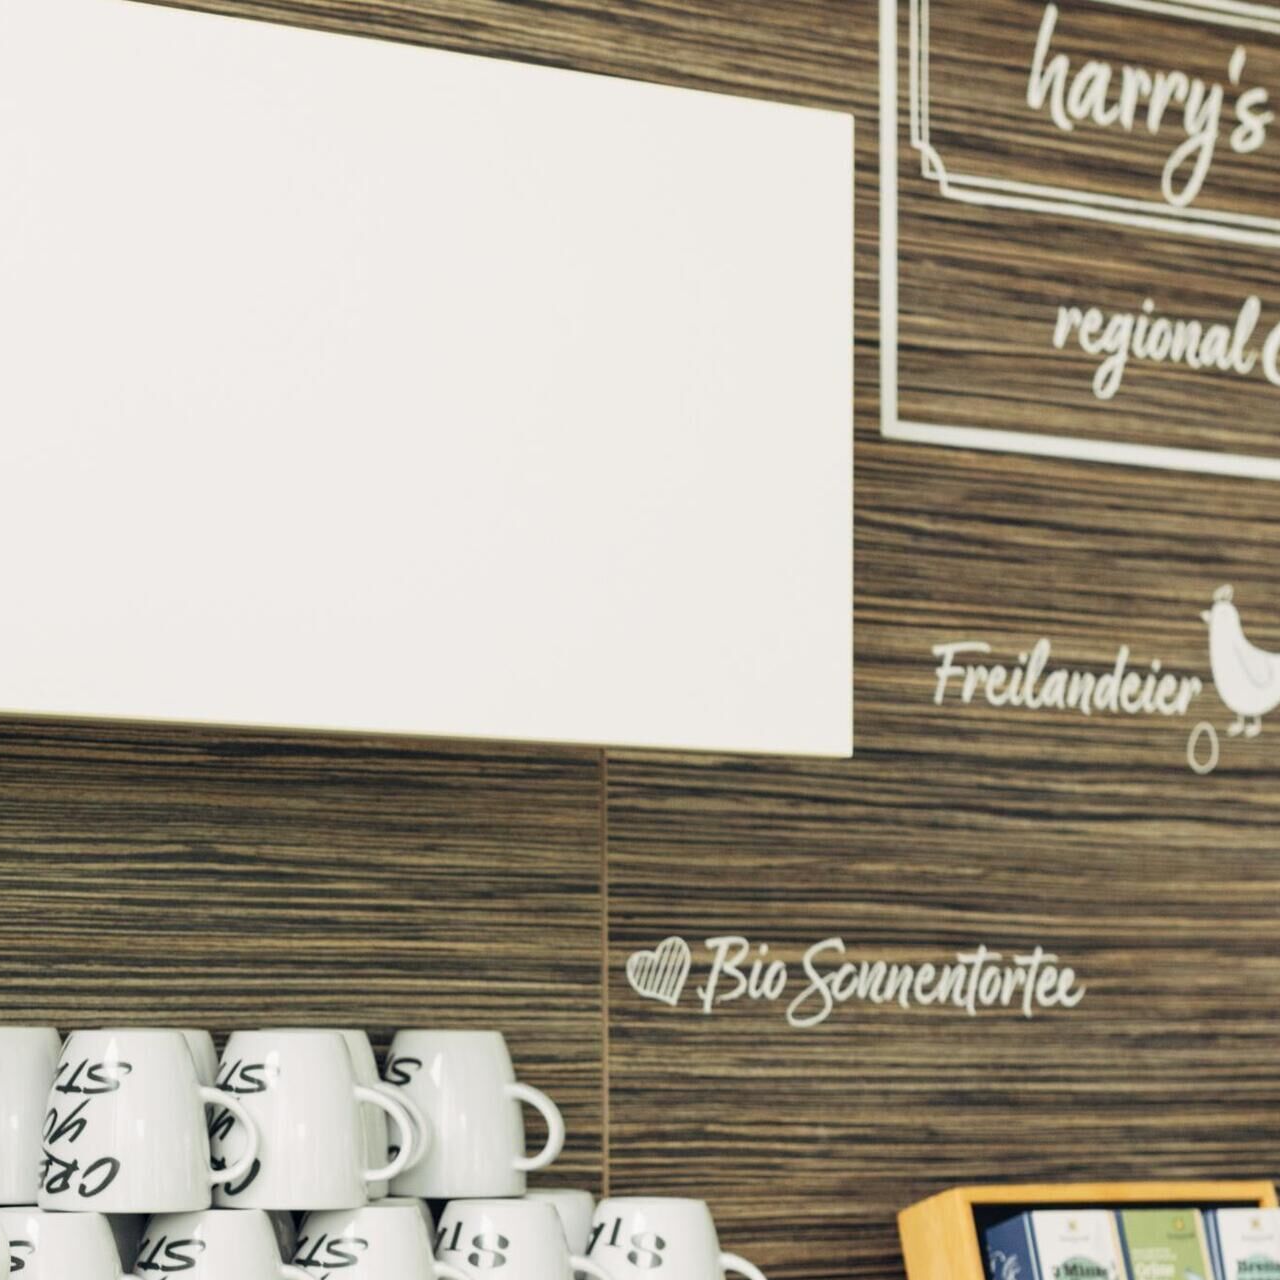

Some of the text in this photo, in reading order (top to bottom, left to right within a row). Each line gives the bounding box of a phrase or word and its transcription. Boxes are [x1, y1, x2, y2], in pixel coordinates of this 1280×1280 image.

[1025, 4, 1274, 207] harry's
[1052, 294, 1260, 400] regional
[932, 637, 1202, 718] Freilandeier
[696, 935, 788, 1014] Bio
